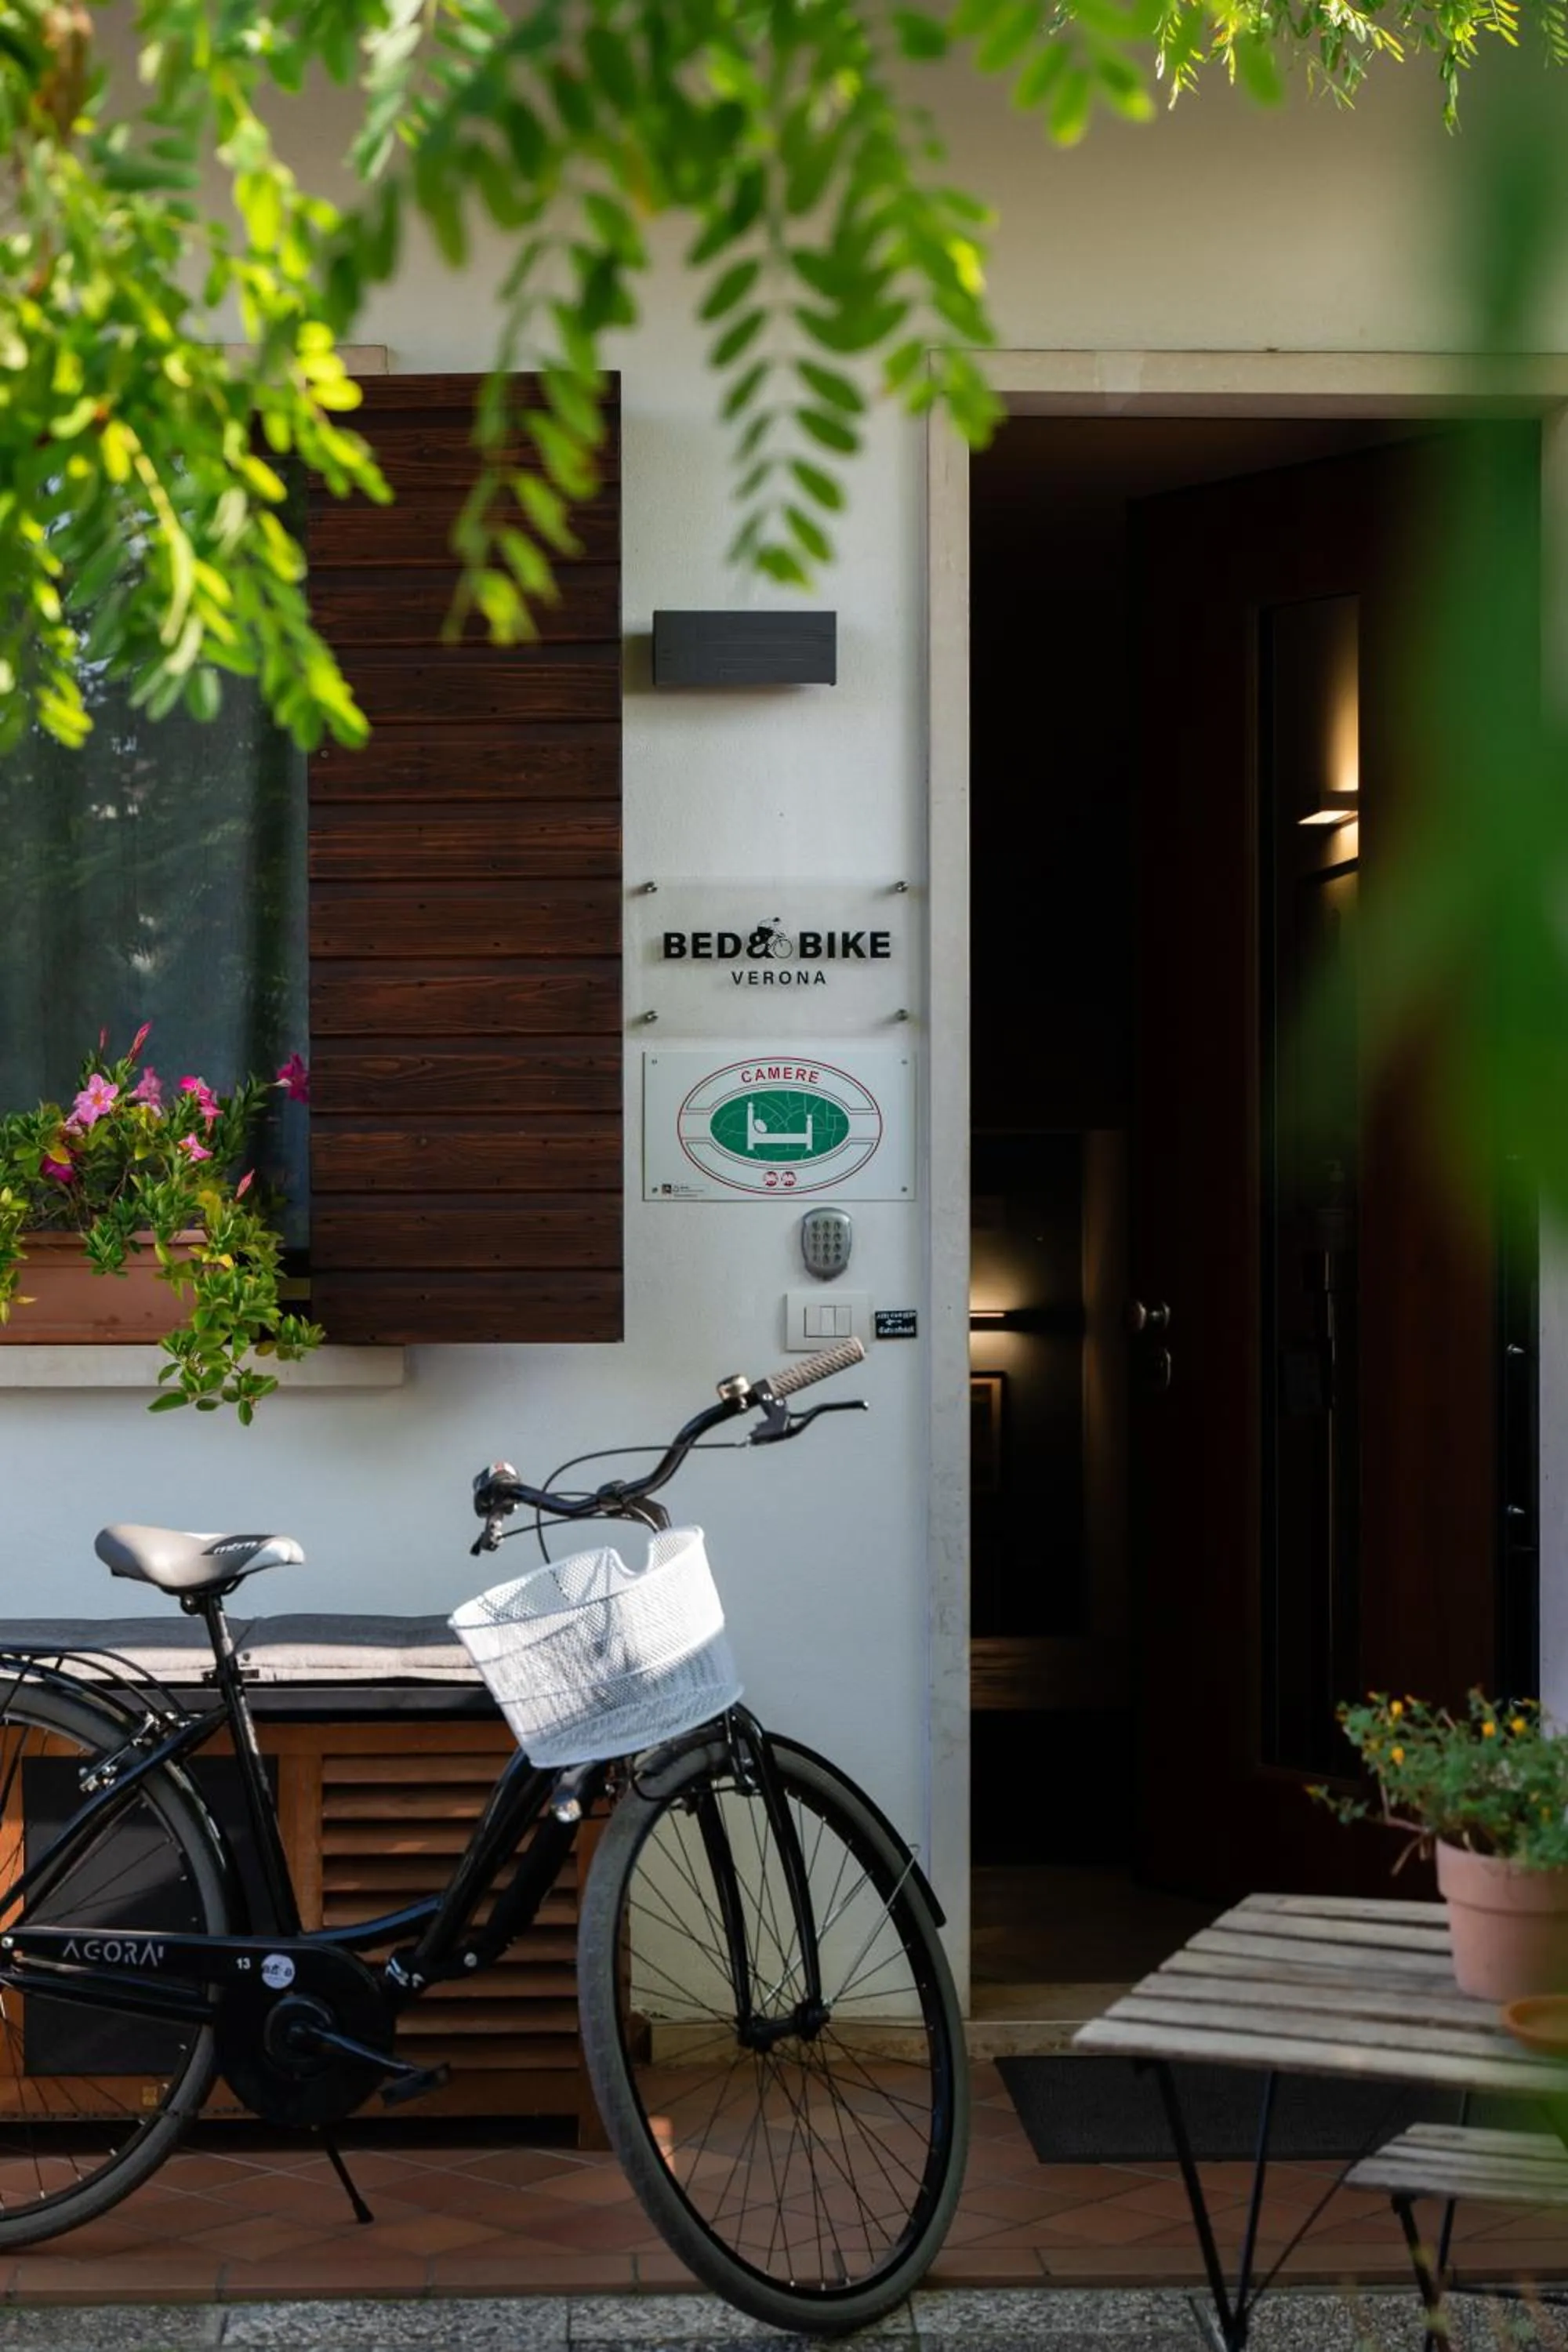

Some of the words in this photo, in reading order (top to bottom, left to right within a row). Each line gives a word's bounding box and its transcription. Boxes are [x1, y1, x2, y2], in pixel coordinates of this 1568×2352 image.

[798, 931, 891, 958] BIKE
[731, 971, 826, 985] VERONA
[741, 1066, 820, 1085] CAMERE
[237, 1957, 251, 1969] 13
